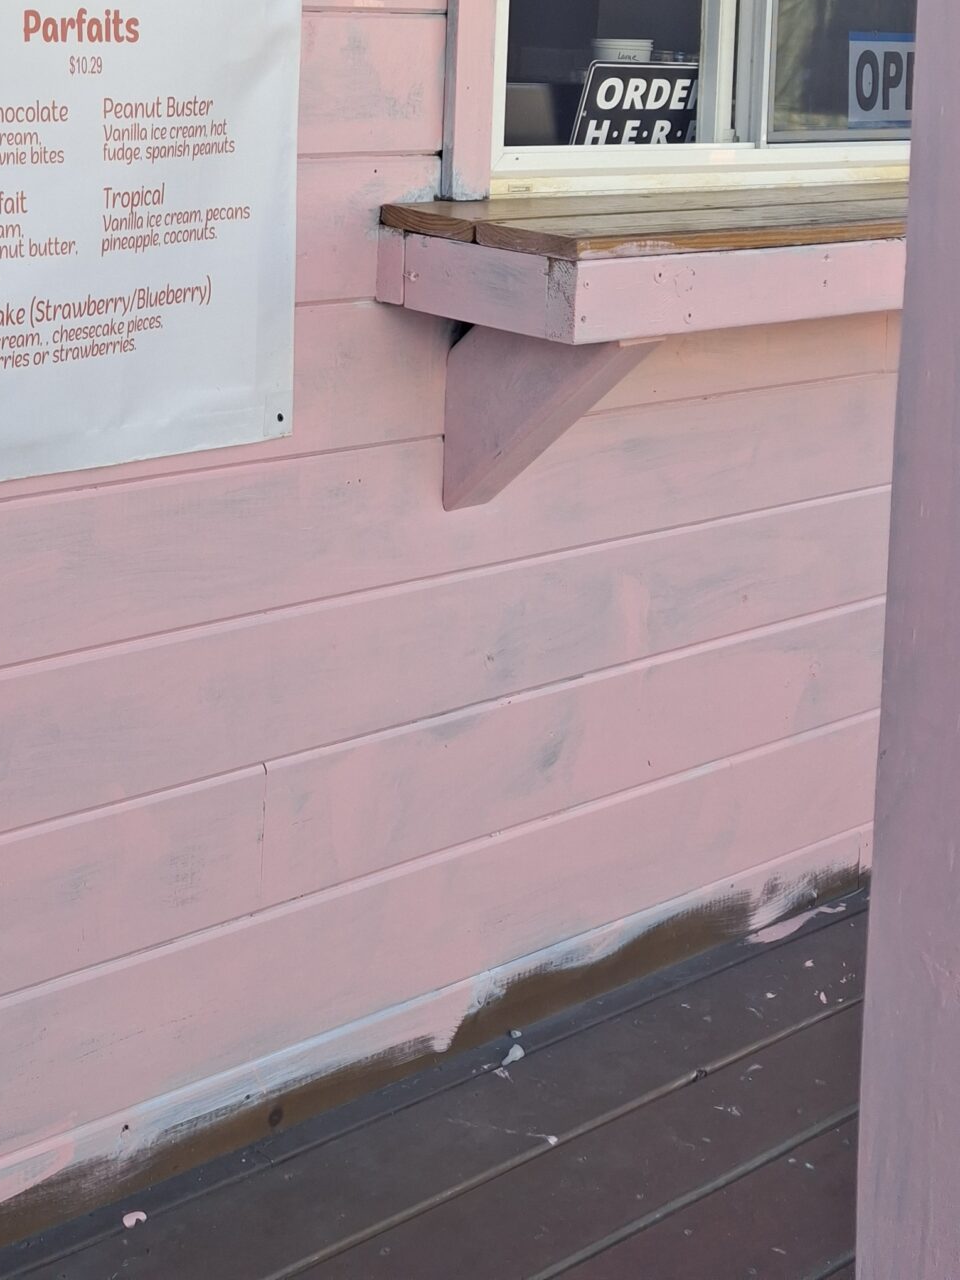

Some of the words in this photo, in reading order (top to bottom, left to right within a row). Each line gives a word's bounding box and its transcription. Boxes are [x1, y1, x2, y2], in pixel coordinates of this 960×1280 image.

[23, 7, 139, 43] Parfaits
[69, 56, 102, 76] $10.29
[103, 96, 162, 118] Peanut
[167, 96, 213, 118] Buster
[103, 123, 147, 141] Vanilla
[151, 124, 167, 140] ice
[210, 119, 227, 136] hot
[31, 146, 64, 164] bites
[146, 140, 189, 163] spanish
[192, 136, 235, 160] peanuts
[104, 182, 165, 211] Tropical
[103, 211, 143, 232] Vanilla
[147, 211, 161, 228] ice
[205, 205, 251, 228] pecans
[30, 275, 212, 328] (Strawberry/Blueberry)
[52, 318, 125, 344] cheesecake
[33, 351, 49, 365] or
